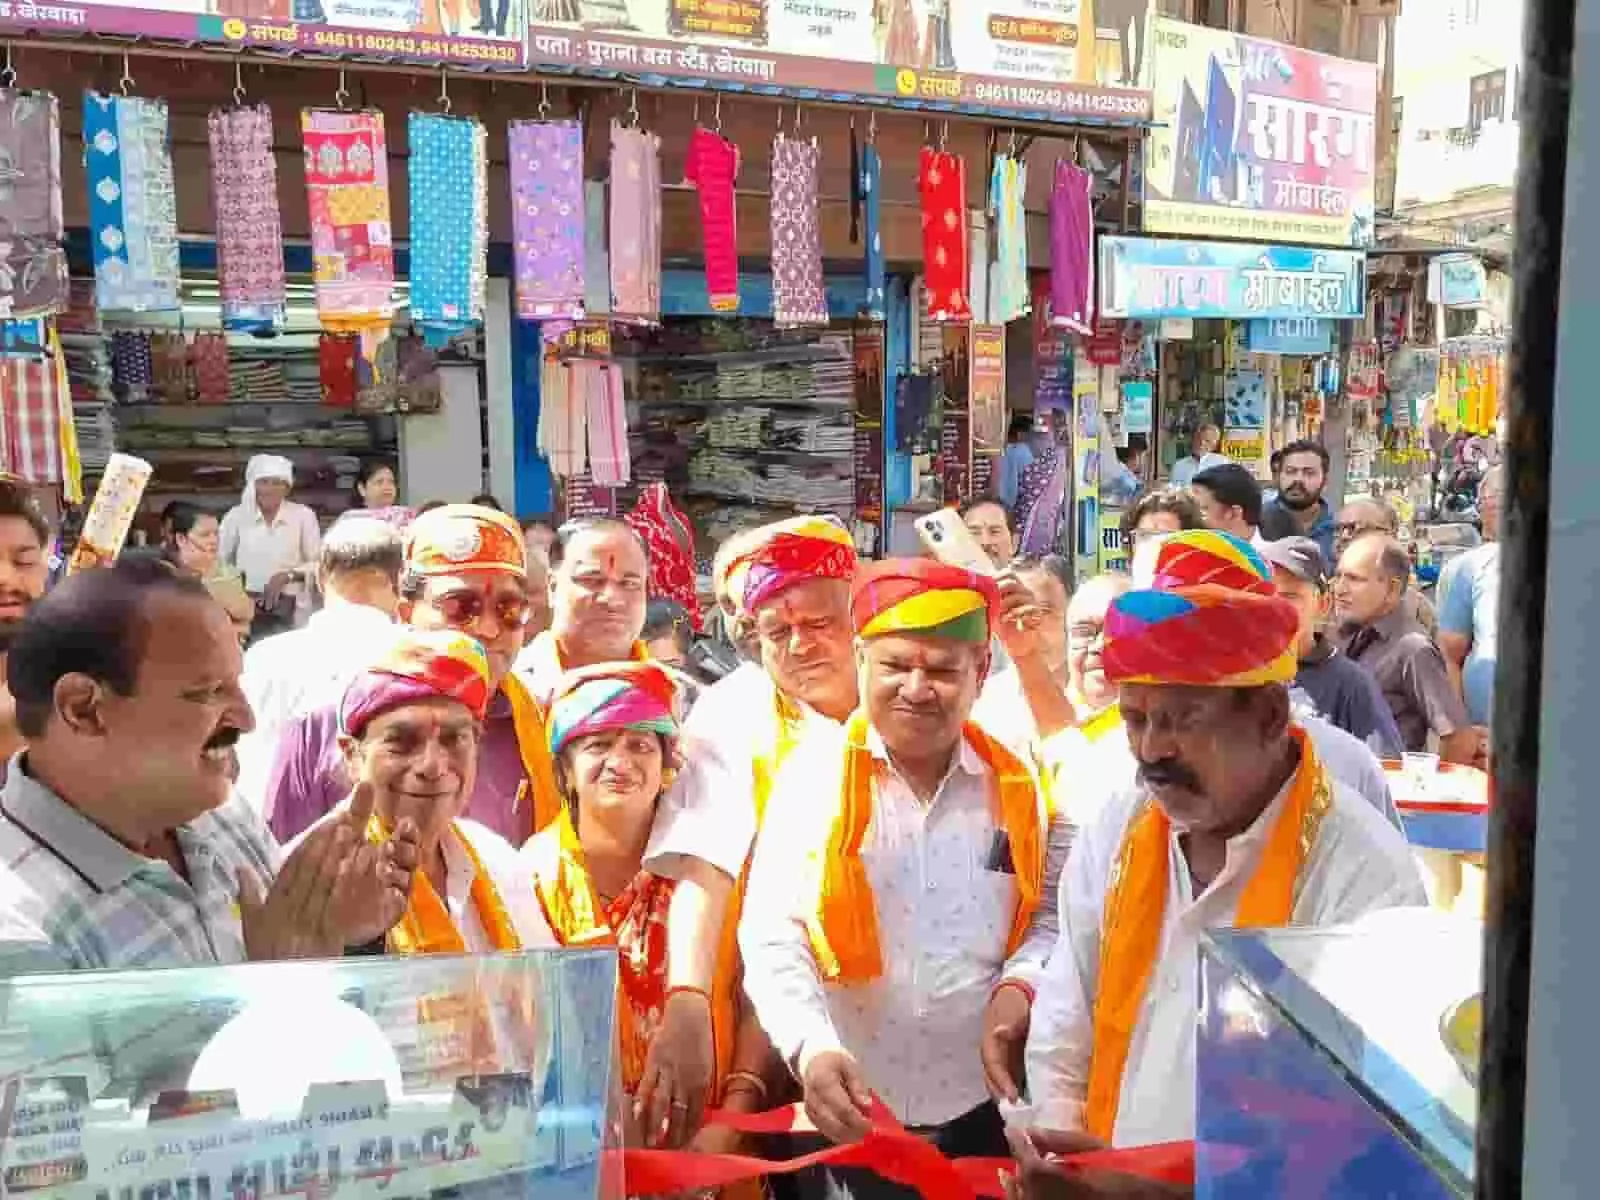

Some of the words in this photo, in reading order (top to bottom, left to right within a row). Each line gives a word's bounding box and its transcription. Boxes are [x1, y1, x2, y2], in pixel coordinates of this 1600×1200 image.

[251, 22, 299, 42] संपर्क
[535, 35, 569, 57] पता
[588, 38, 636, 66] पुराना
[920, 73, 960, 97] संपर्क
[1242, 254, 1345, 314] मोबाईल
